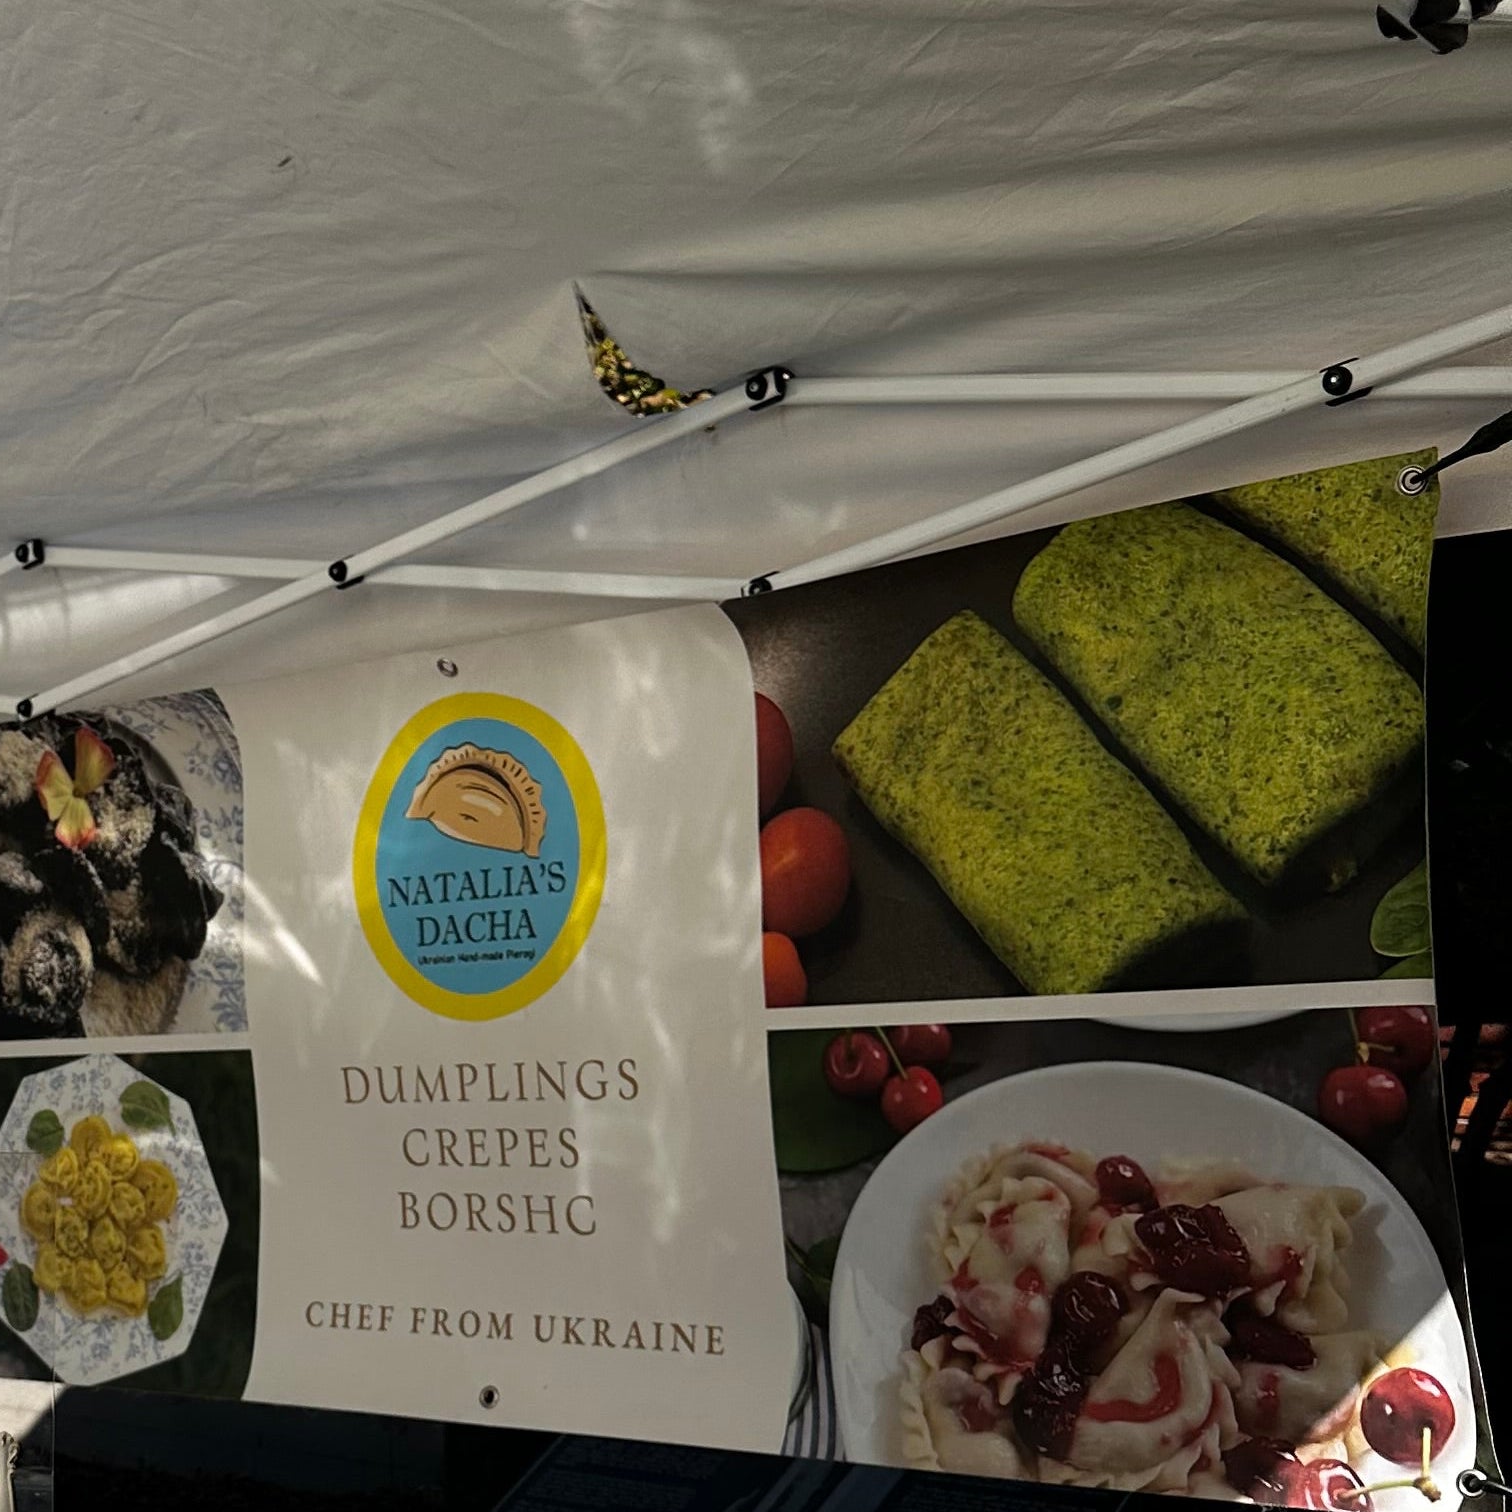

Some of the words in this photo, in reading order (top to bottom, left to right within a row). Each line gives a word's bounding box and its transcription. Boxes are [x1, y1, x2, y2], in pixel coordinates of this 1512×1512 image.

[388, 862, 566, 908] NATALIA'S
[416, 909, 537, 948] DACHA
[341, 1058, 640, 1105] DUMPLINGS
[402, 1127, 580, 1169] CREPES
[398, 1191, 597, 1236] BORSHC
[305, 1300, 395, 1333] CHEF
[410, 1307, 514, 1340] FROM
[534, 1314, 726, 1357] UKRAINE
